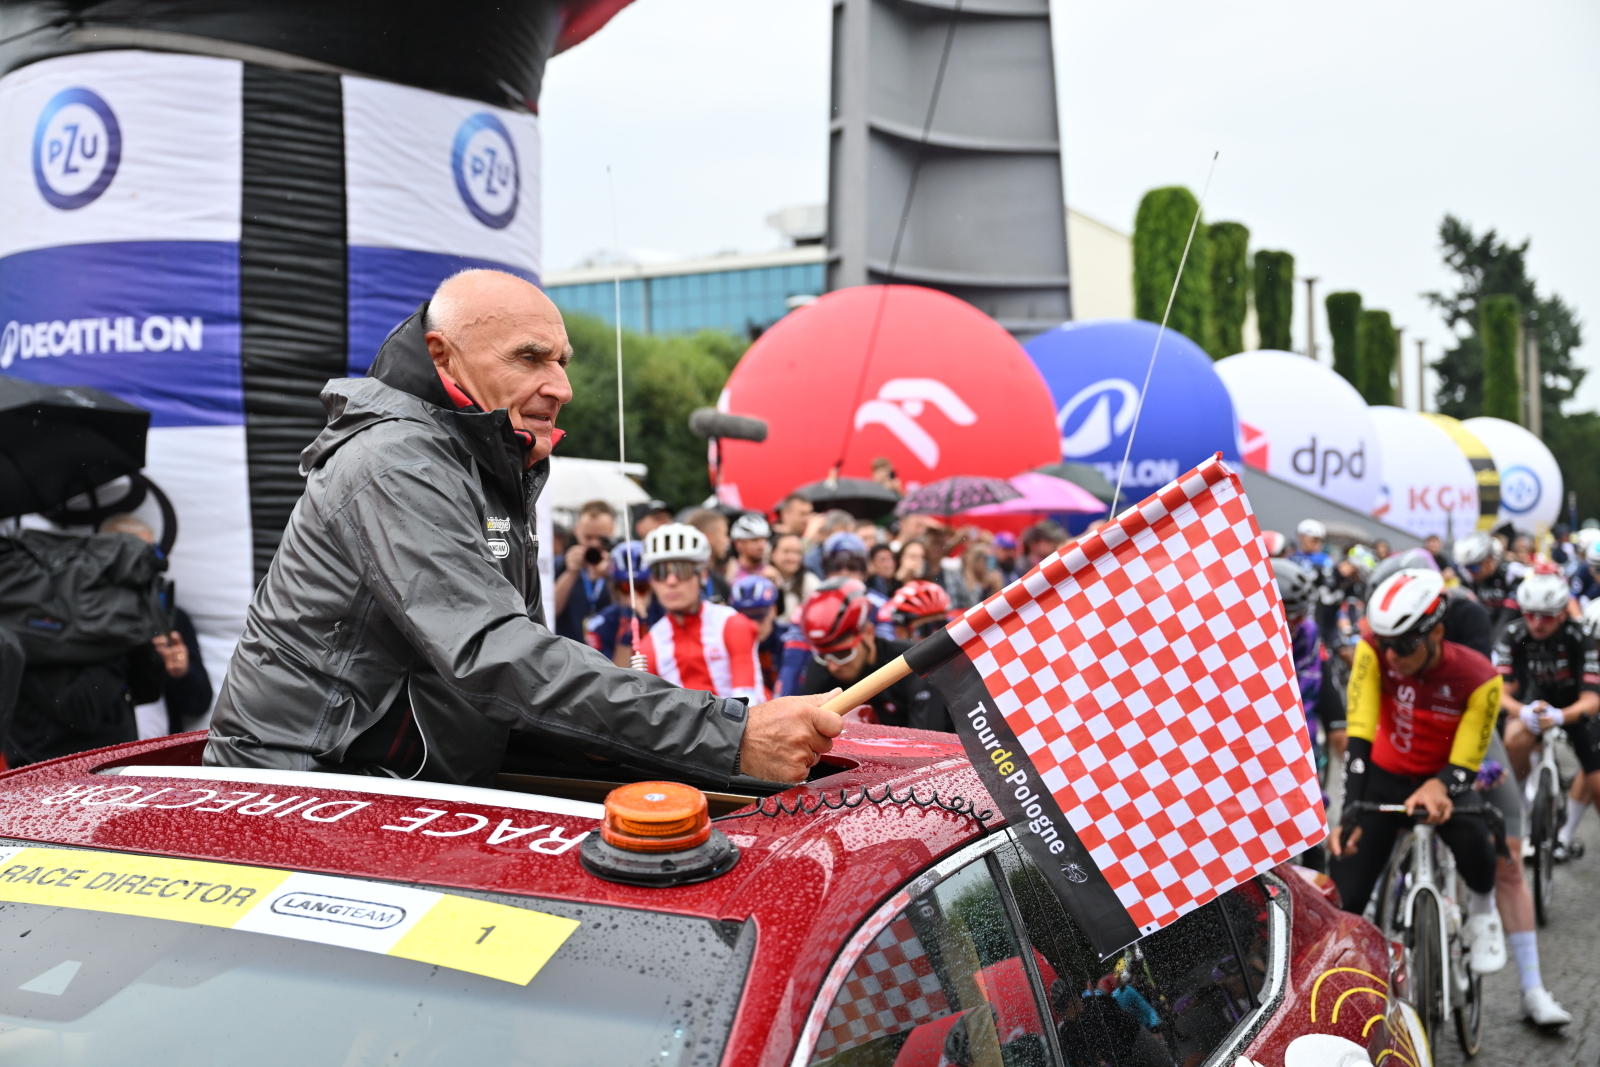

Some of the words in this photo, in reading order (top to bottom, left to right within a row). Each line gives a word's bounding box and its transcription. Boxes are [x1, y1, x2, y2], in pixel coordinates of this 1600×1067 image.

[48, 124, 98, 174] PZU
[471, 147, 509, 195] PZU
[20, 315, 203, 360] DECATHLON
[1292, 437, 1365, 488] dpd
[42, 784, 372, 823] DIRECTOR
[381, 806, 592, 856] RACE
[0, 864, 89, 888] RACE
[83, 871, 257, 907] DIRECTOR
[283, 898, 396, 924] LANGTEAM
[475, 925, 496, 945] 1
